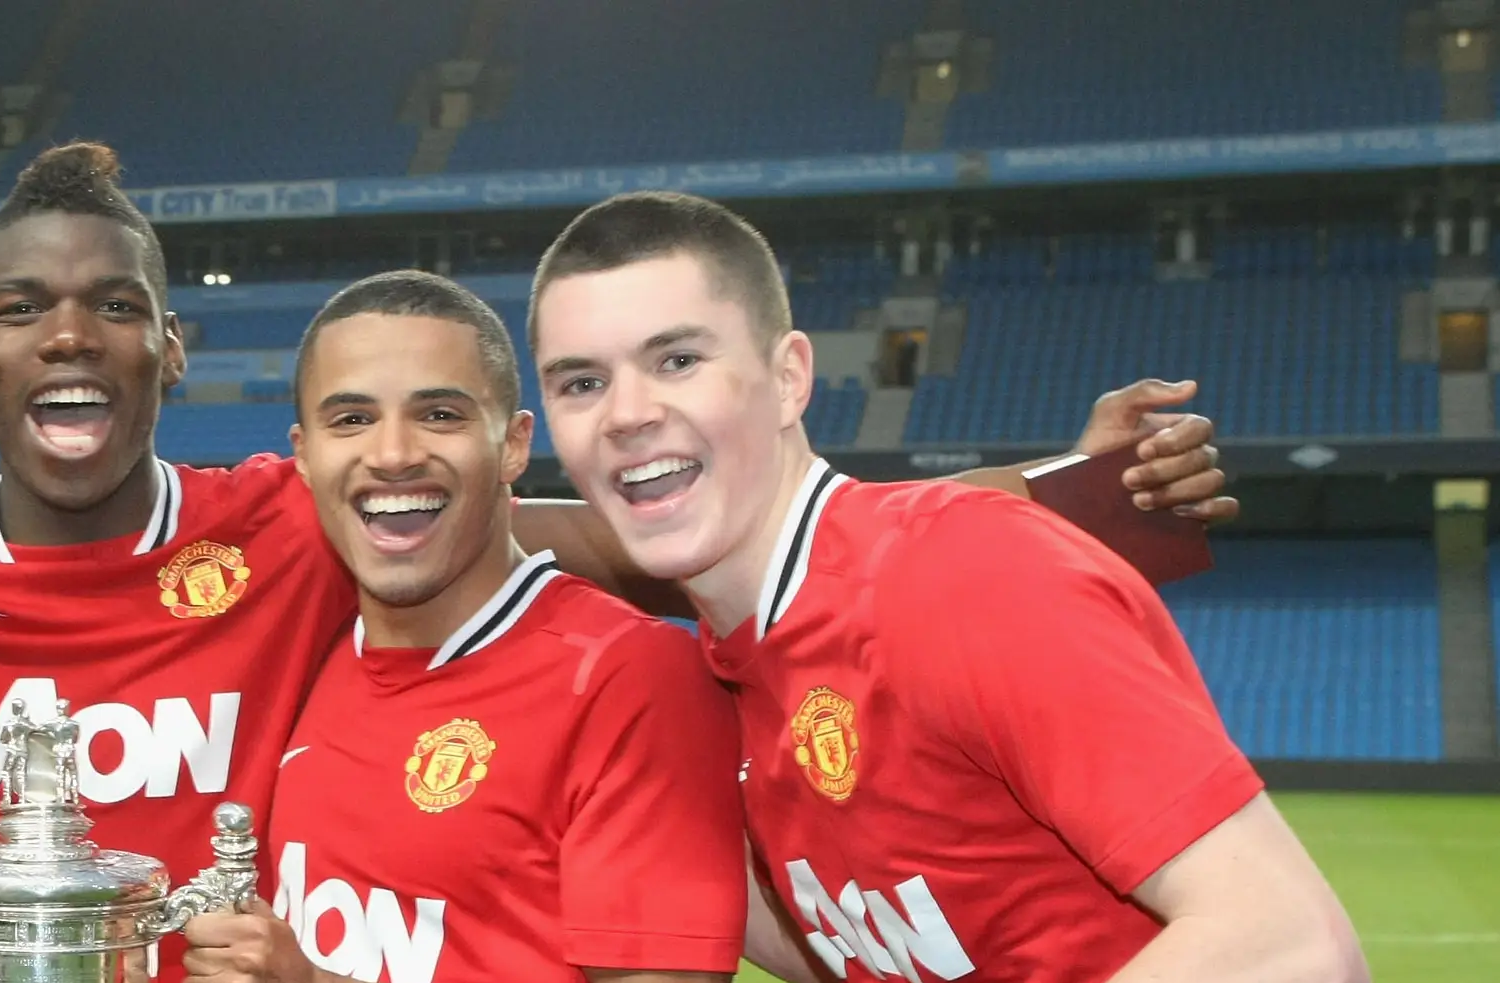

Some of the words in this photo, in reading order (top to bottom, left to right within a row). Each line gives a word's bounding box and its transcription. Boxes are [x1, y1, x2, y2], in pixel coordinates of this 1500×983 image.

[164, 545, 239, 584] MANCHESTER
[421, 727, 488, 758] MANCHESTER
[414, 787, 461, 805] UNITED
